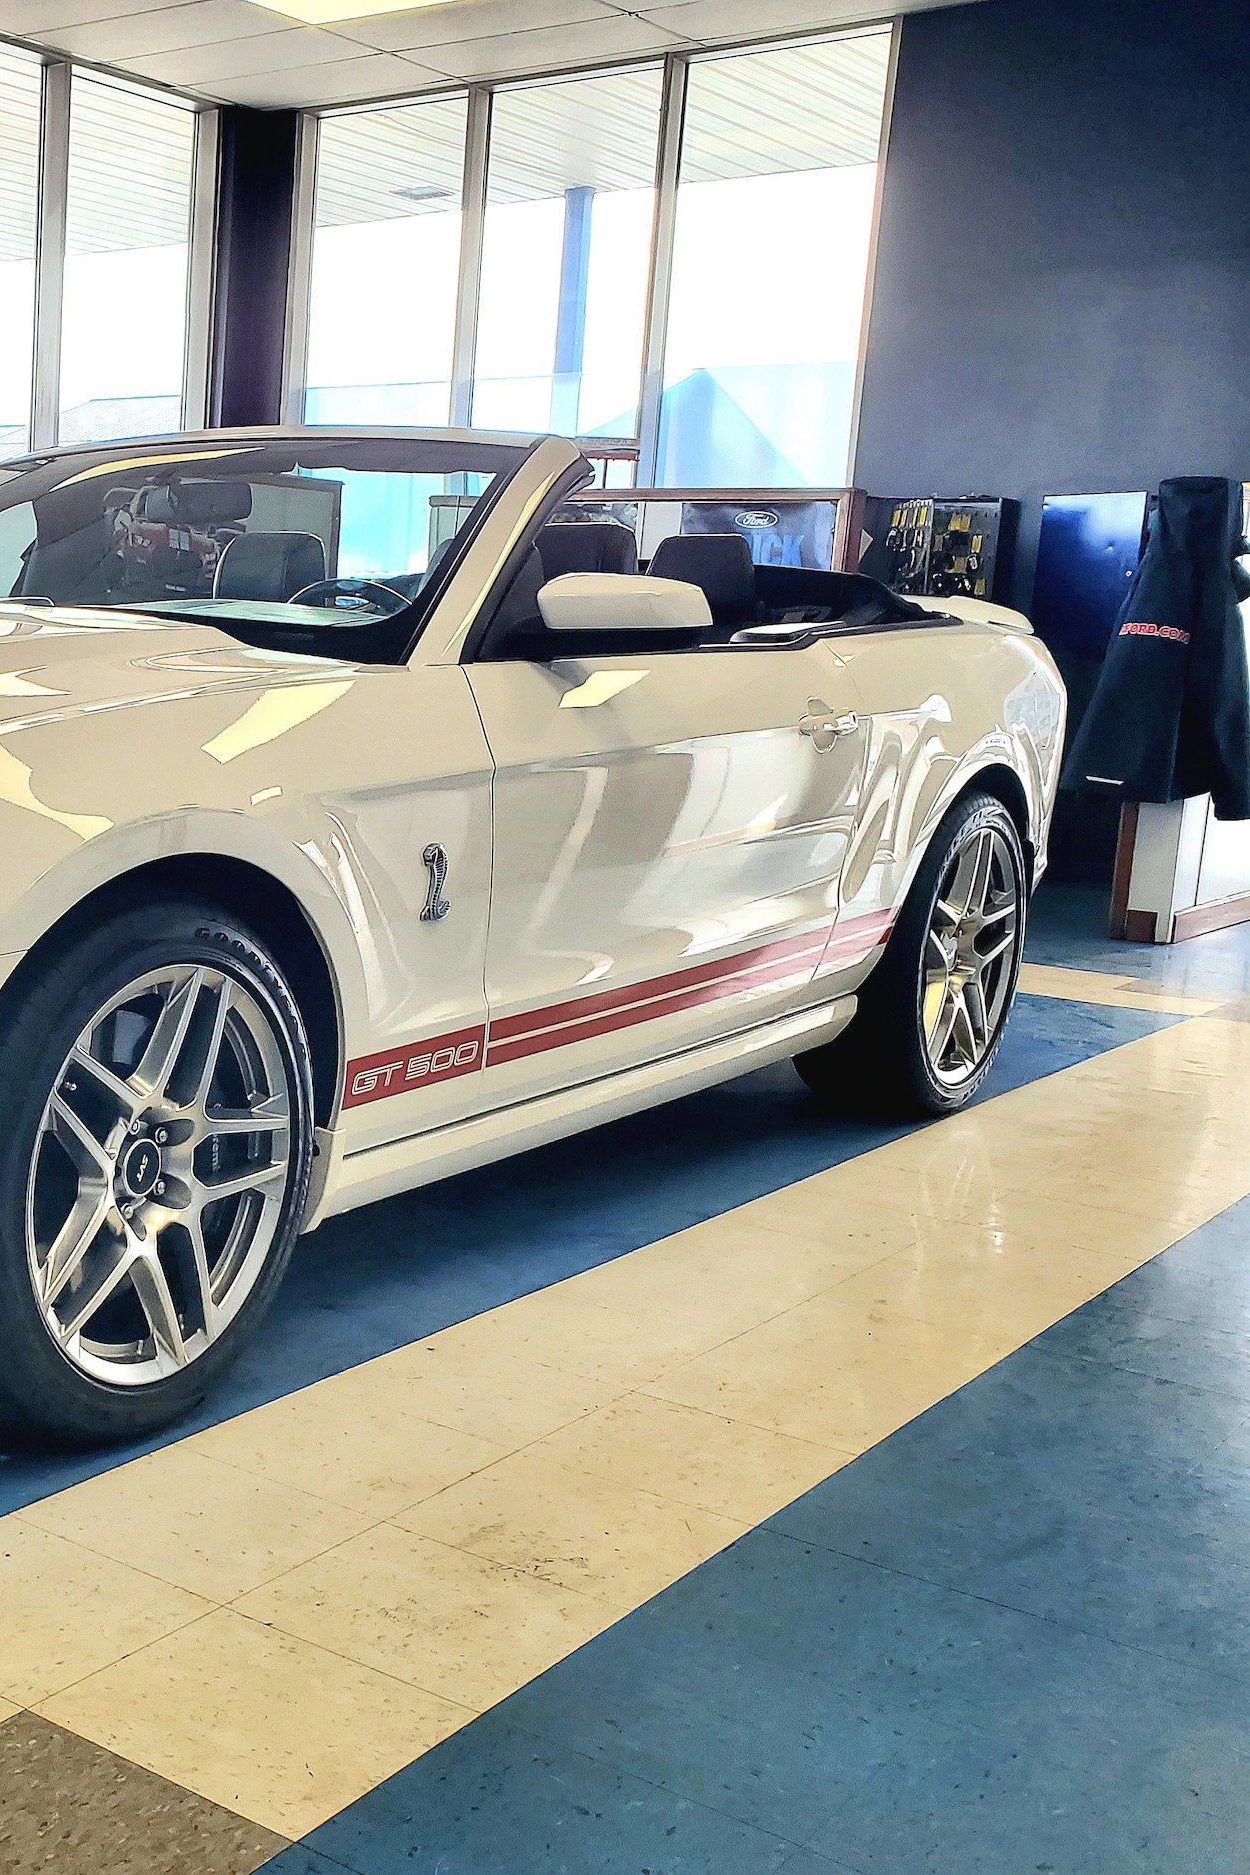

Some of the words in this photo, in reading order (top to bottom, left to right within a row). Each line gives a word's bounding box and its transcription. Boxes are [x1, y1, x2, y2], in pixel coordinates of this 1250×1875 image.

[1119, 622, 1190, 645] FORD.COM
[351, 1060, 404, 1096] GT
[405, 1040, 479, 1081] 500
